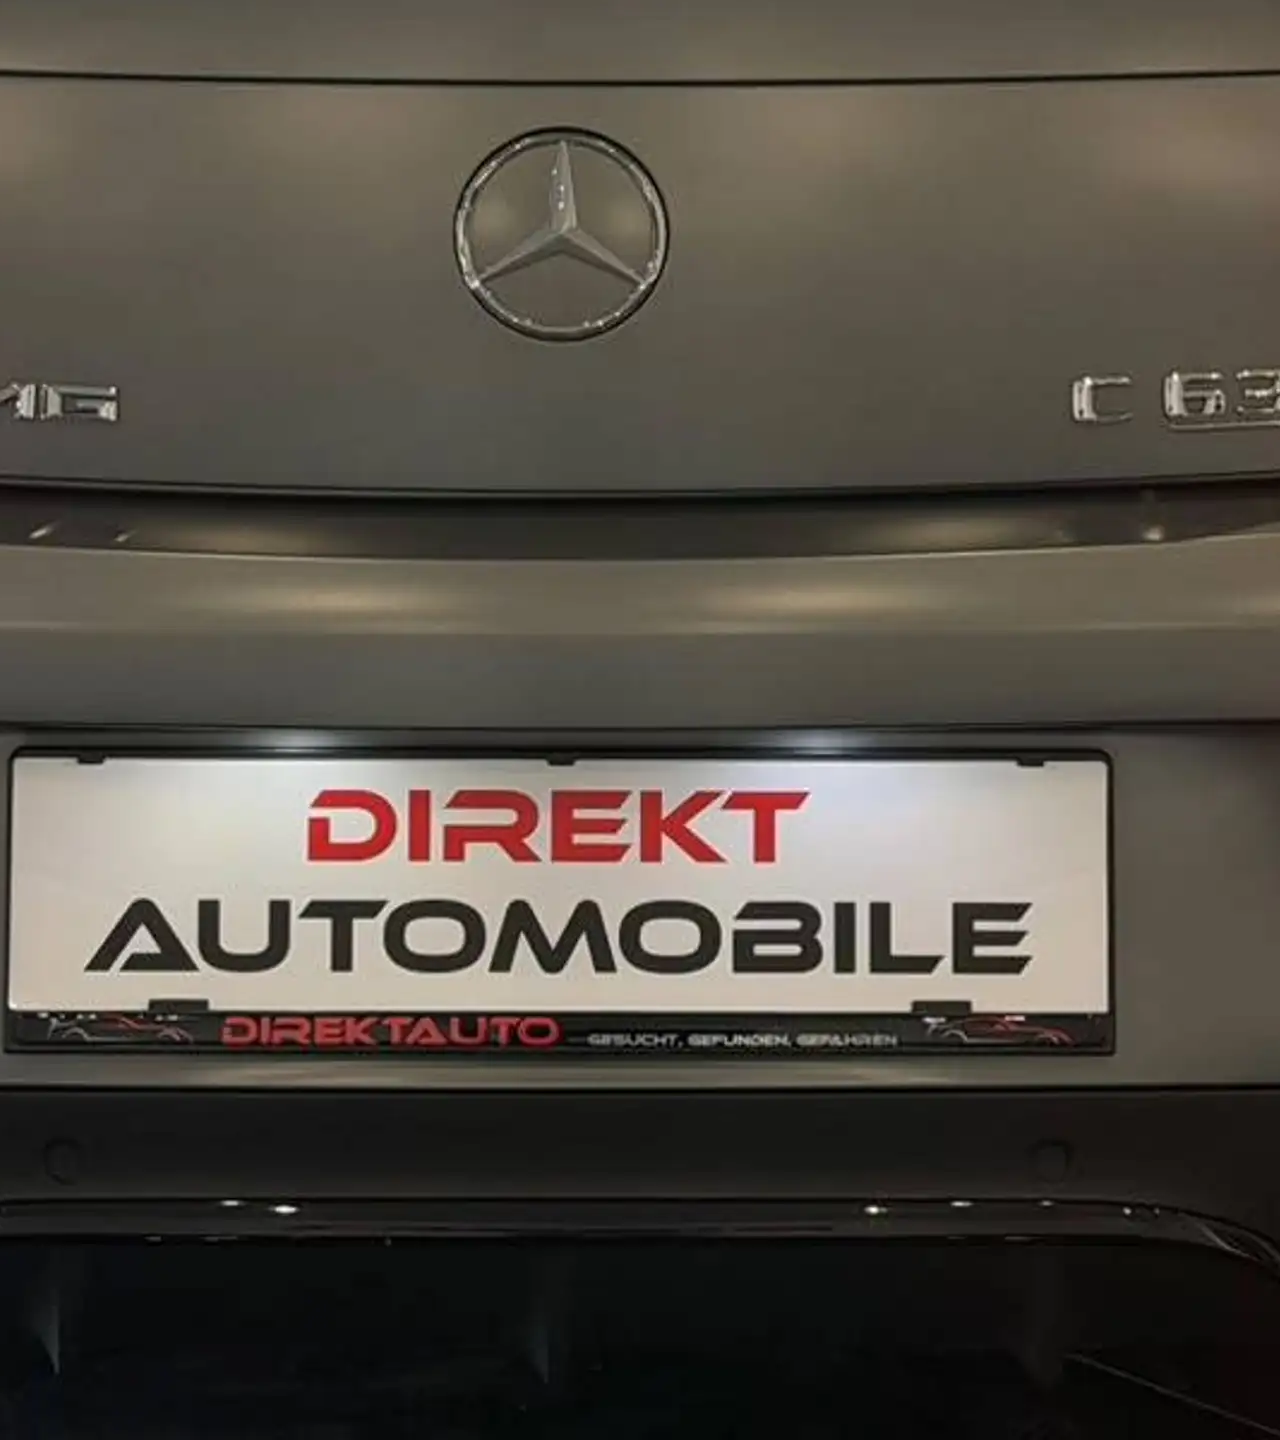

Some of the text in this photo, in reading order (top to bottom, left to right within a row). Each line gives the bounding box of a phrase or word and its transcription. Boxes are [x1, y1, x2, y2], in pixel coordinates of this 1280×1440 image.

[1072, 375, 1133, 422] C
[308, 789, 810, 862] DIREKT
[85, 899, 1032, 975] AUTOMOBILE
[222, 1016, 559, 1046] DIREKTAUTO
